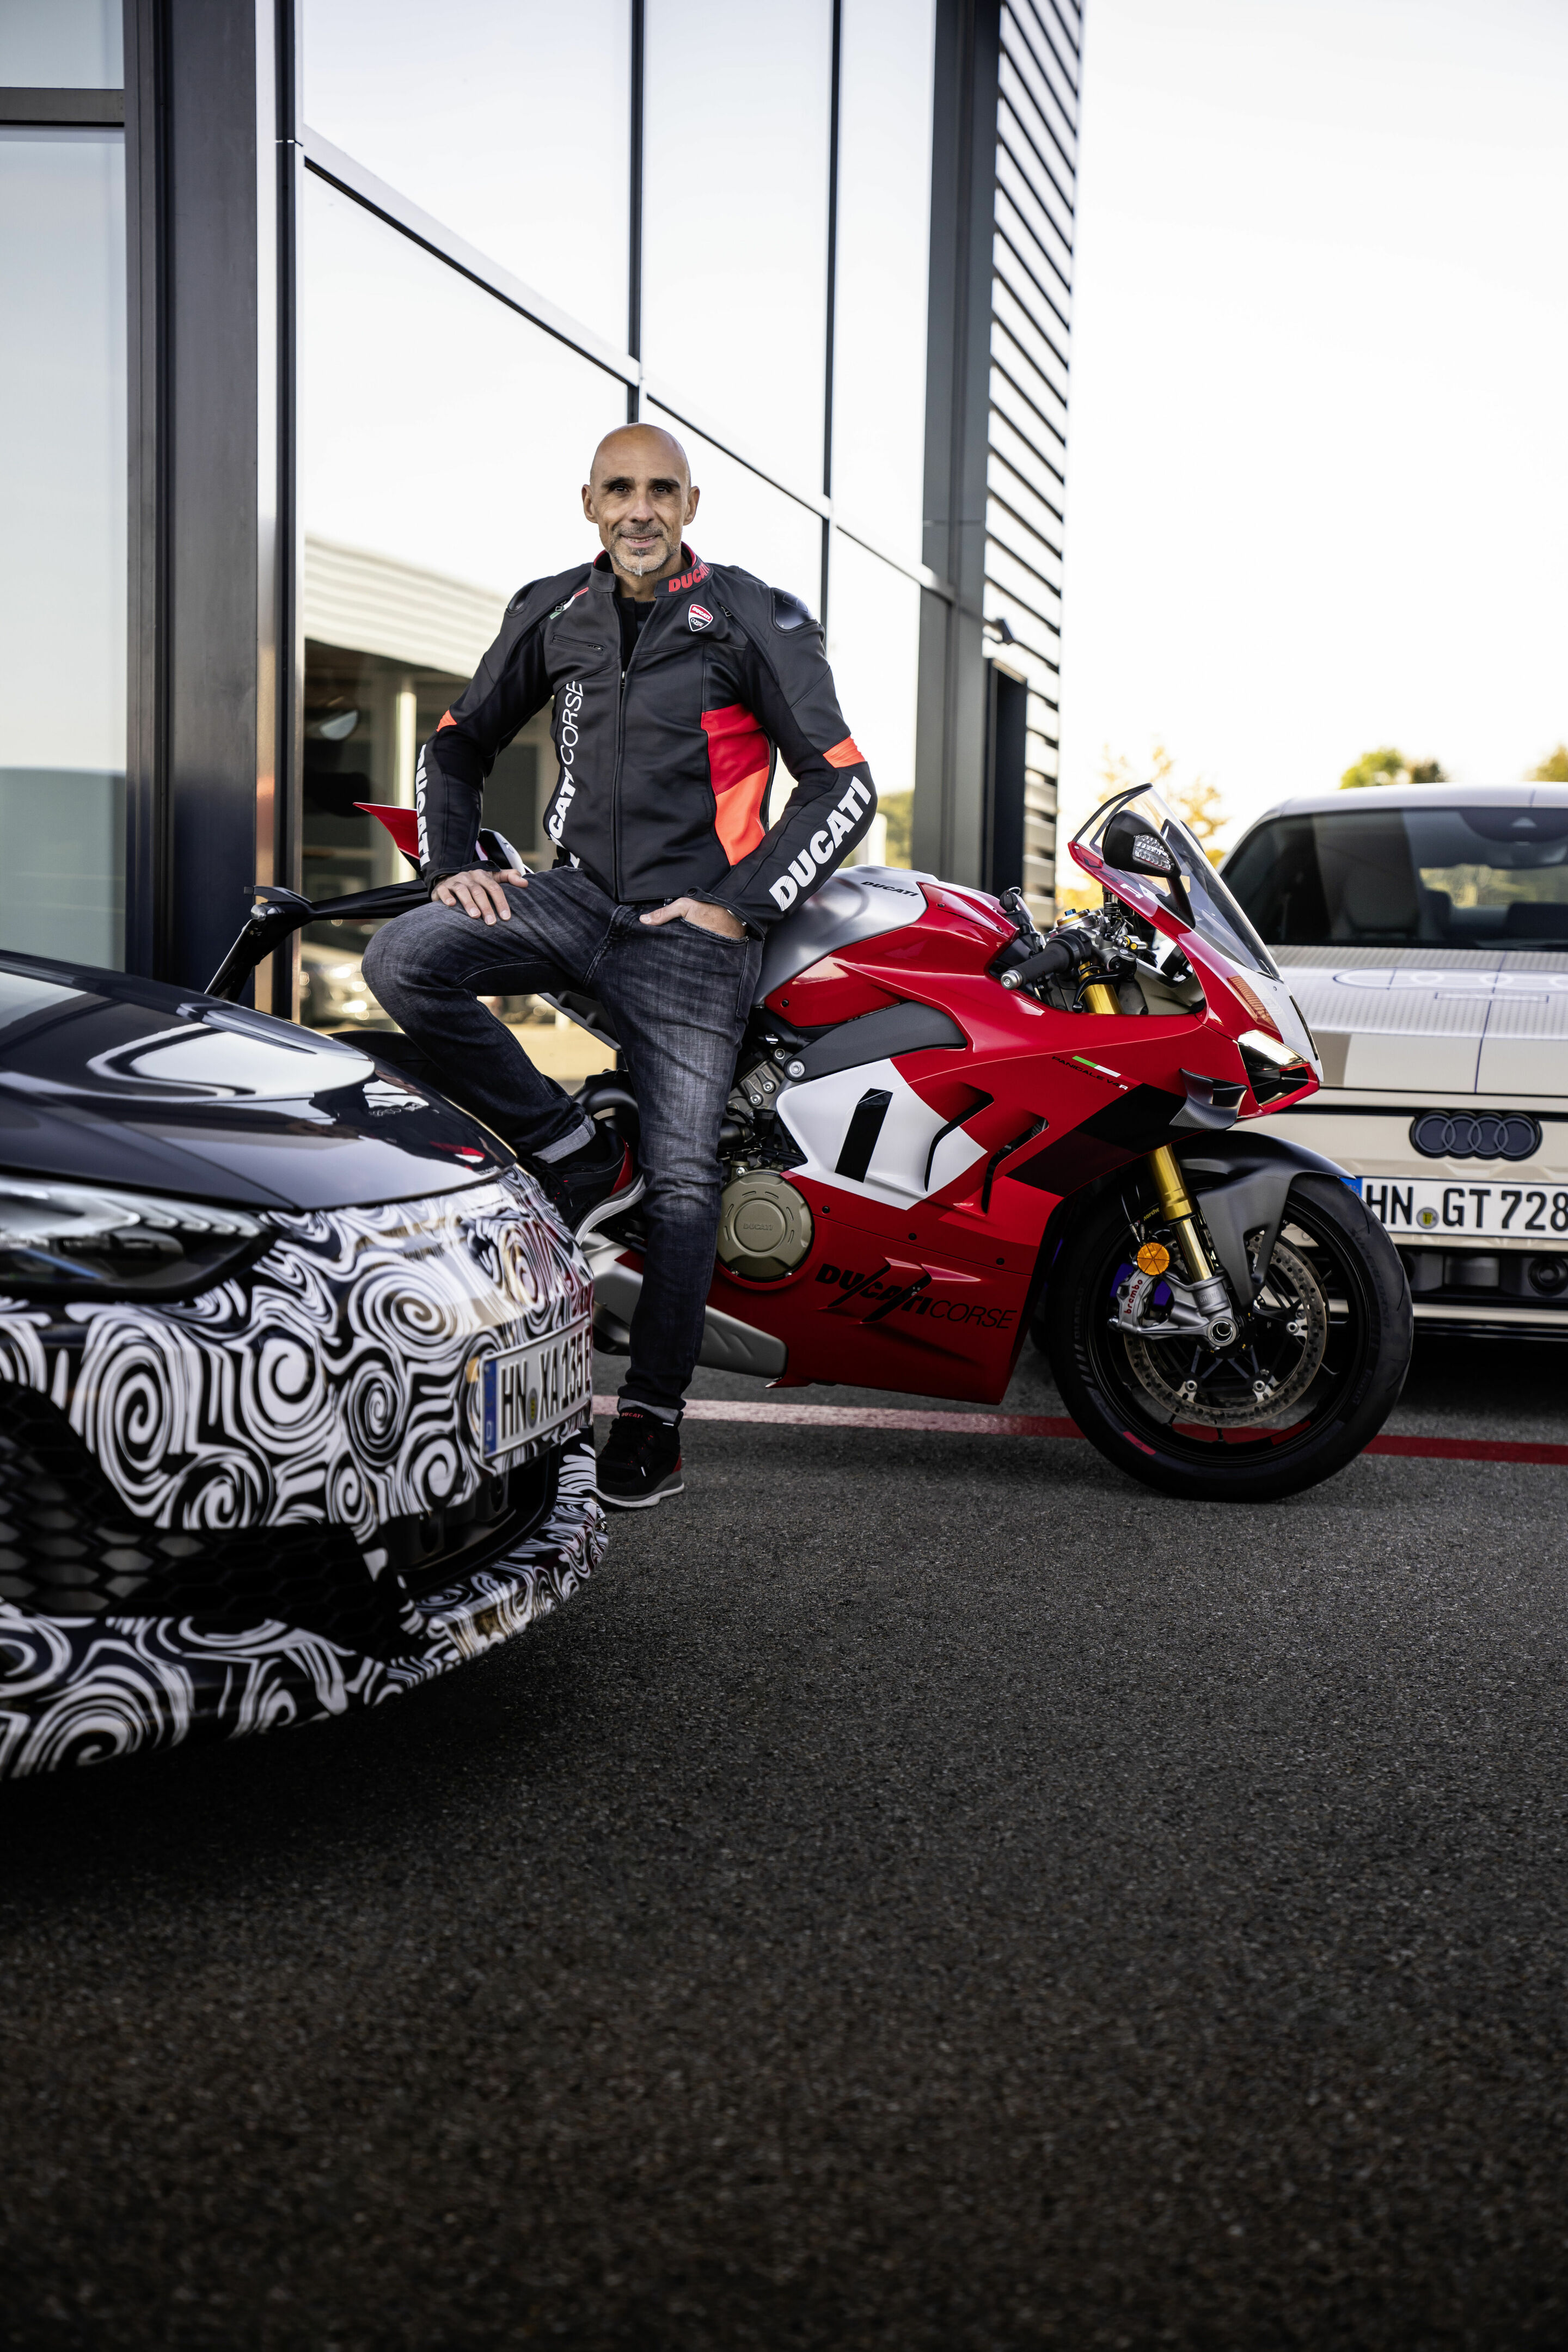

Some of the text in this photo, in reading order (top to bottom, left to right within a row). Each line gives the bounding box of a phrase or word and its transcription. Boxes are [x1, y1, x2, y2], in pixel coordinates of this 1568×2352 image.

[690, 618, 705, 627] CORSE
[691, 607, 711, 620] DUCATI
[560, 681, 584, 765] CORSE
[769, 776, 871, 911] DUCATI
[861, 881, 919, 897] DUCATI
[1051, 1056, 1129, 1091] PANIGALE V4R
[1366, 1184, 1568, 1232] HN GT 728
[815, 1263, 1018, 1330] DUCATI CORSE
[1124, 1279, 1143, 1314] brembo
[500, 1358, 526, 1440] HN
[537, 1344, 558, 1424] XA
